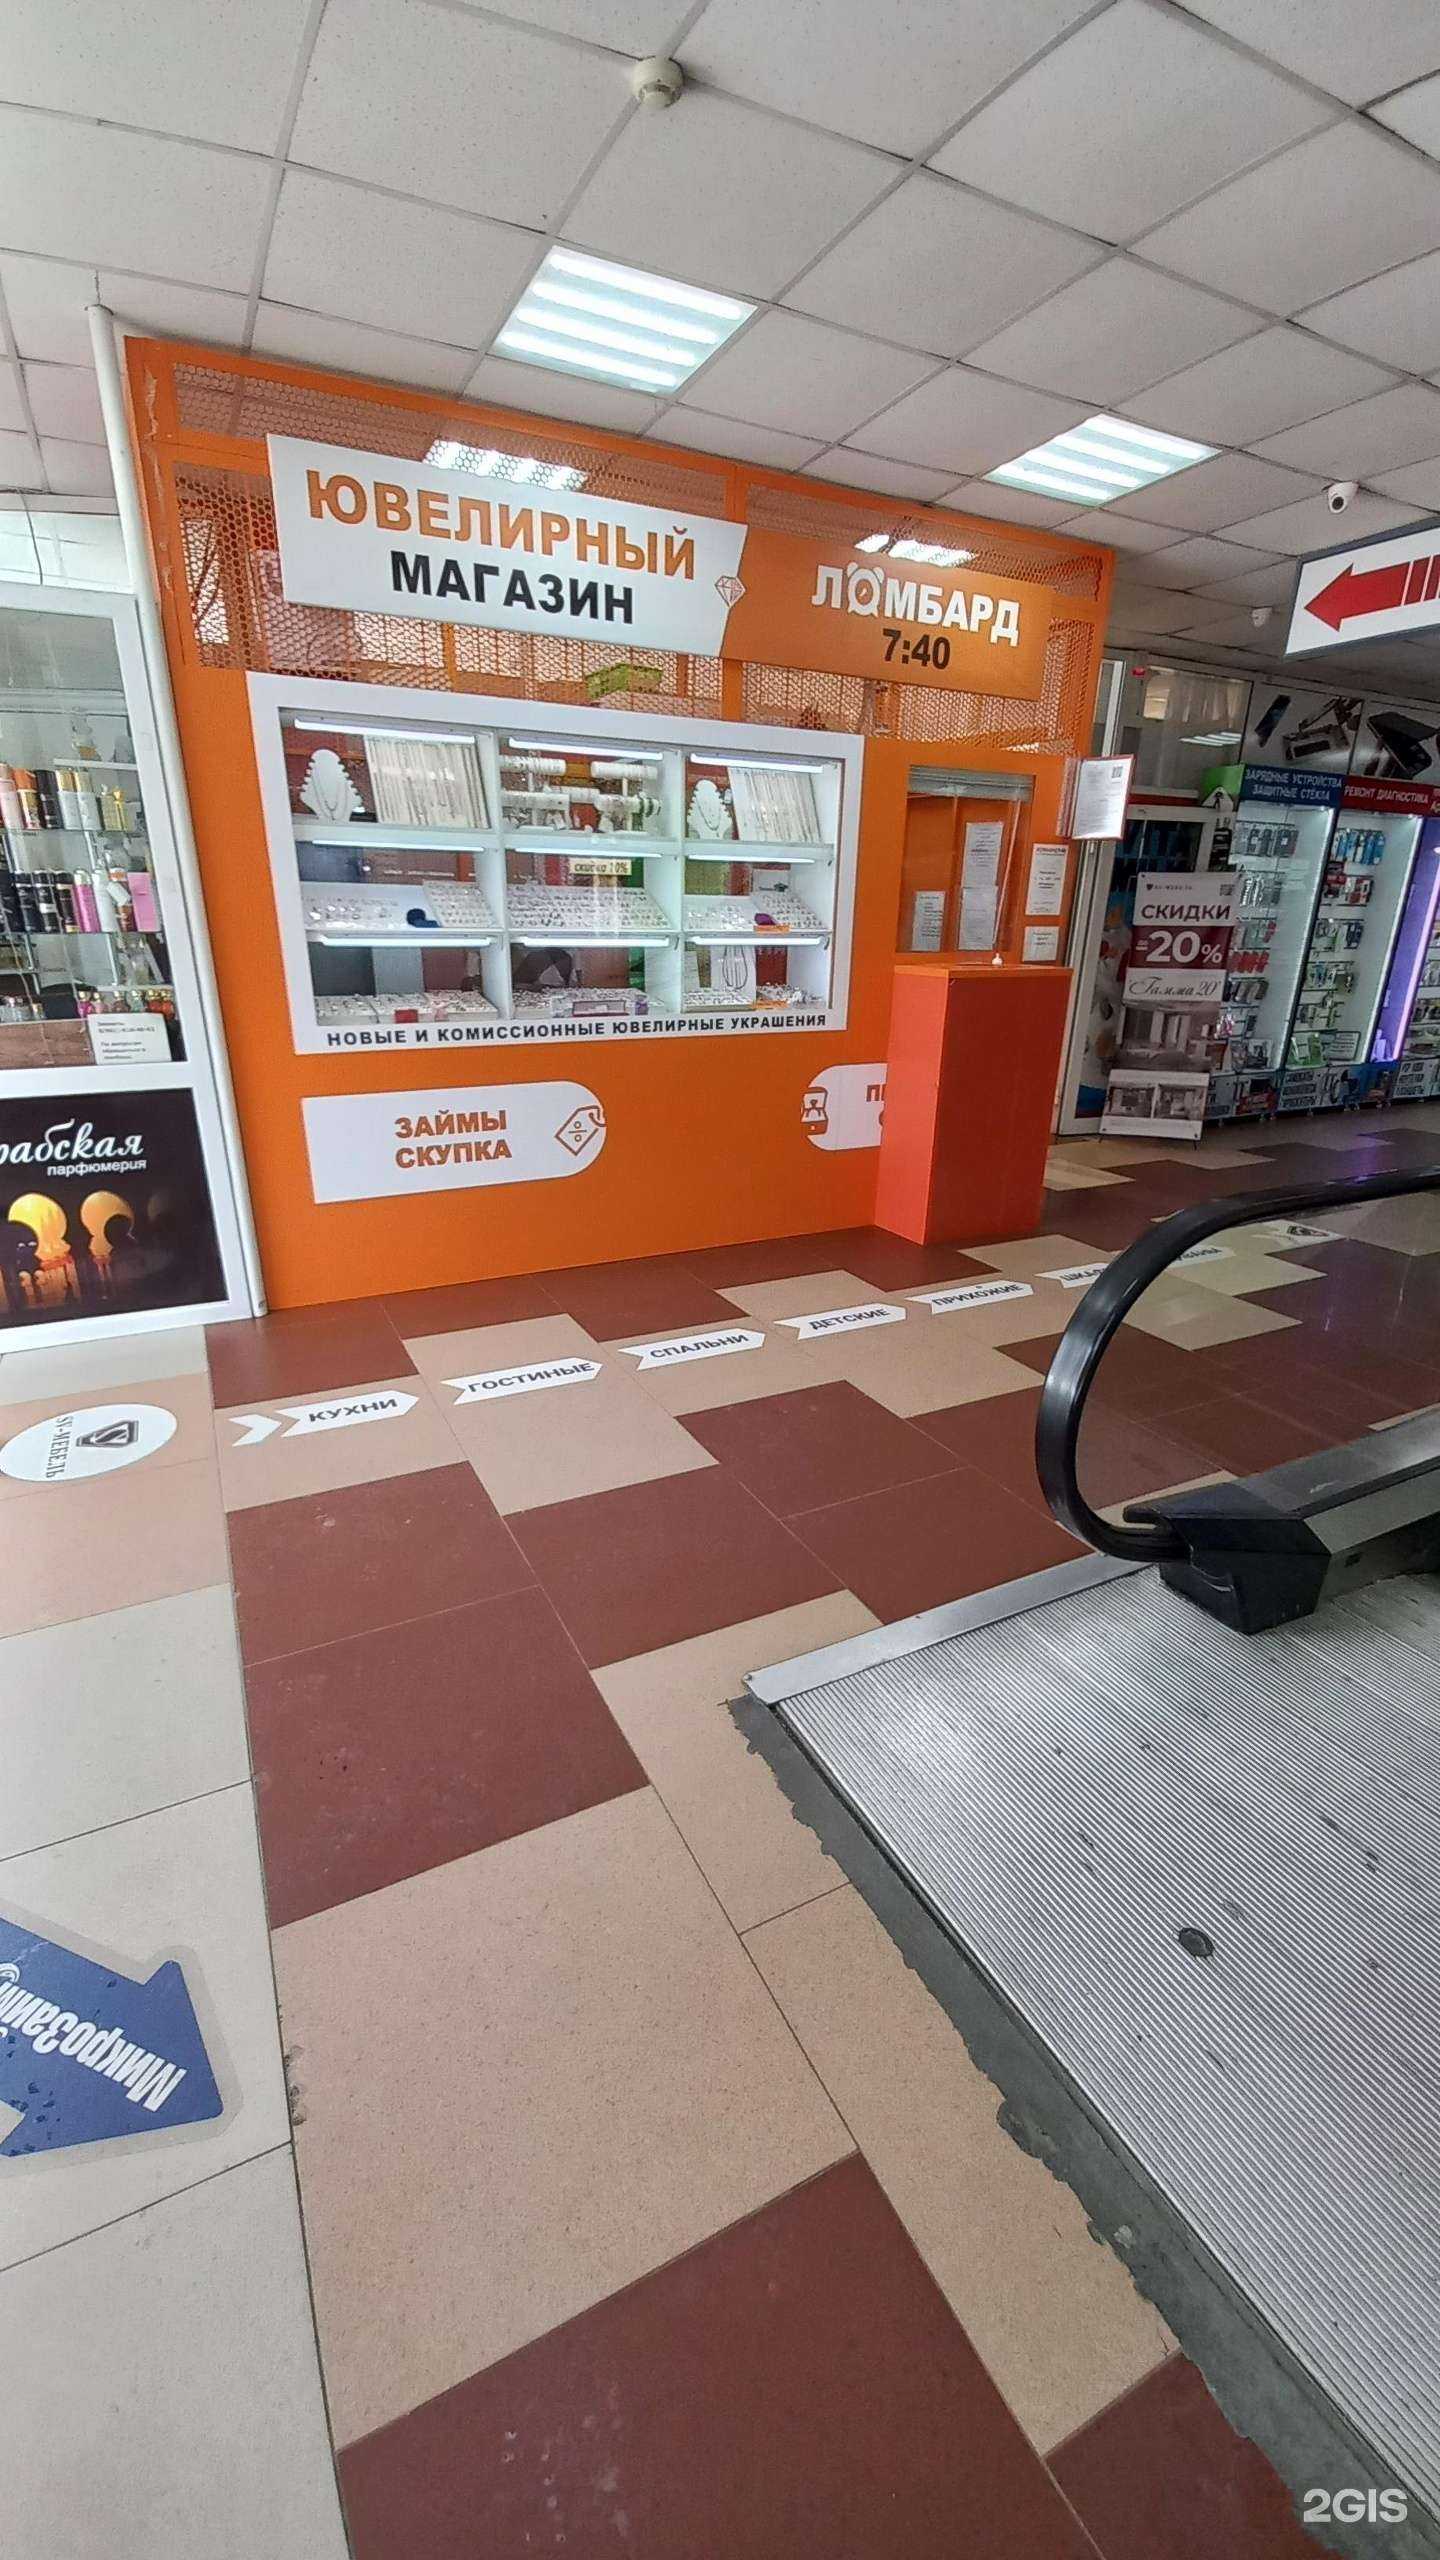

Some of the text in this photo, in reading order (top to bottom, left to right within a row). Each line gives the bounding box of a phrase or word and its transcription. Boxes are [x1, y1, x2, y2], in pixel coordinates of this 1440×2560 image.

[305, 468, 696, 581] ЮВЕЛИРНЫЙ
[390, 550, 635, 625] МАГАЗИН
[810, 561, 1021, 648] ЛОМБАРД
[882, 628, 951, 670] 7:40
[1344, 785, 1376, 799] РЕМОНТ
[1141, 904, 1231, 922] СКИДКИ
[328, 1013, 828, 1047] НОВЫЕ И КОМИССИОННЫЕ ЮВЕЛИРНЫЕ УКРАШЕНИЯ
[394, 1109, 507, 1138] ЗАЙМЫ
[47, 1159, 147, 1177] парфюмерия
[395, 1139, 512, 1168] СКУПКА
[932, 1284, 1023, 1306] ПРИХОЖИЕ
[809, 1308, 890, 1330] ДЕТСКИЕ
[650, 1334, 749, 1358] СПАЛЬНИ
[468, 1362, 595, 1393] ГОСТИНЫЕ
[309, 1399, 397, 1422] КУХНИ
